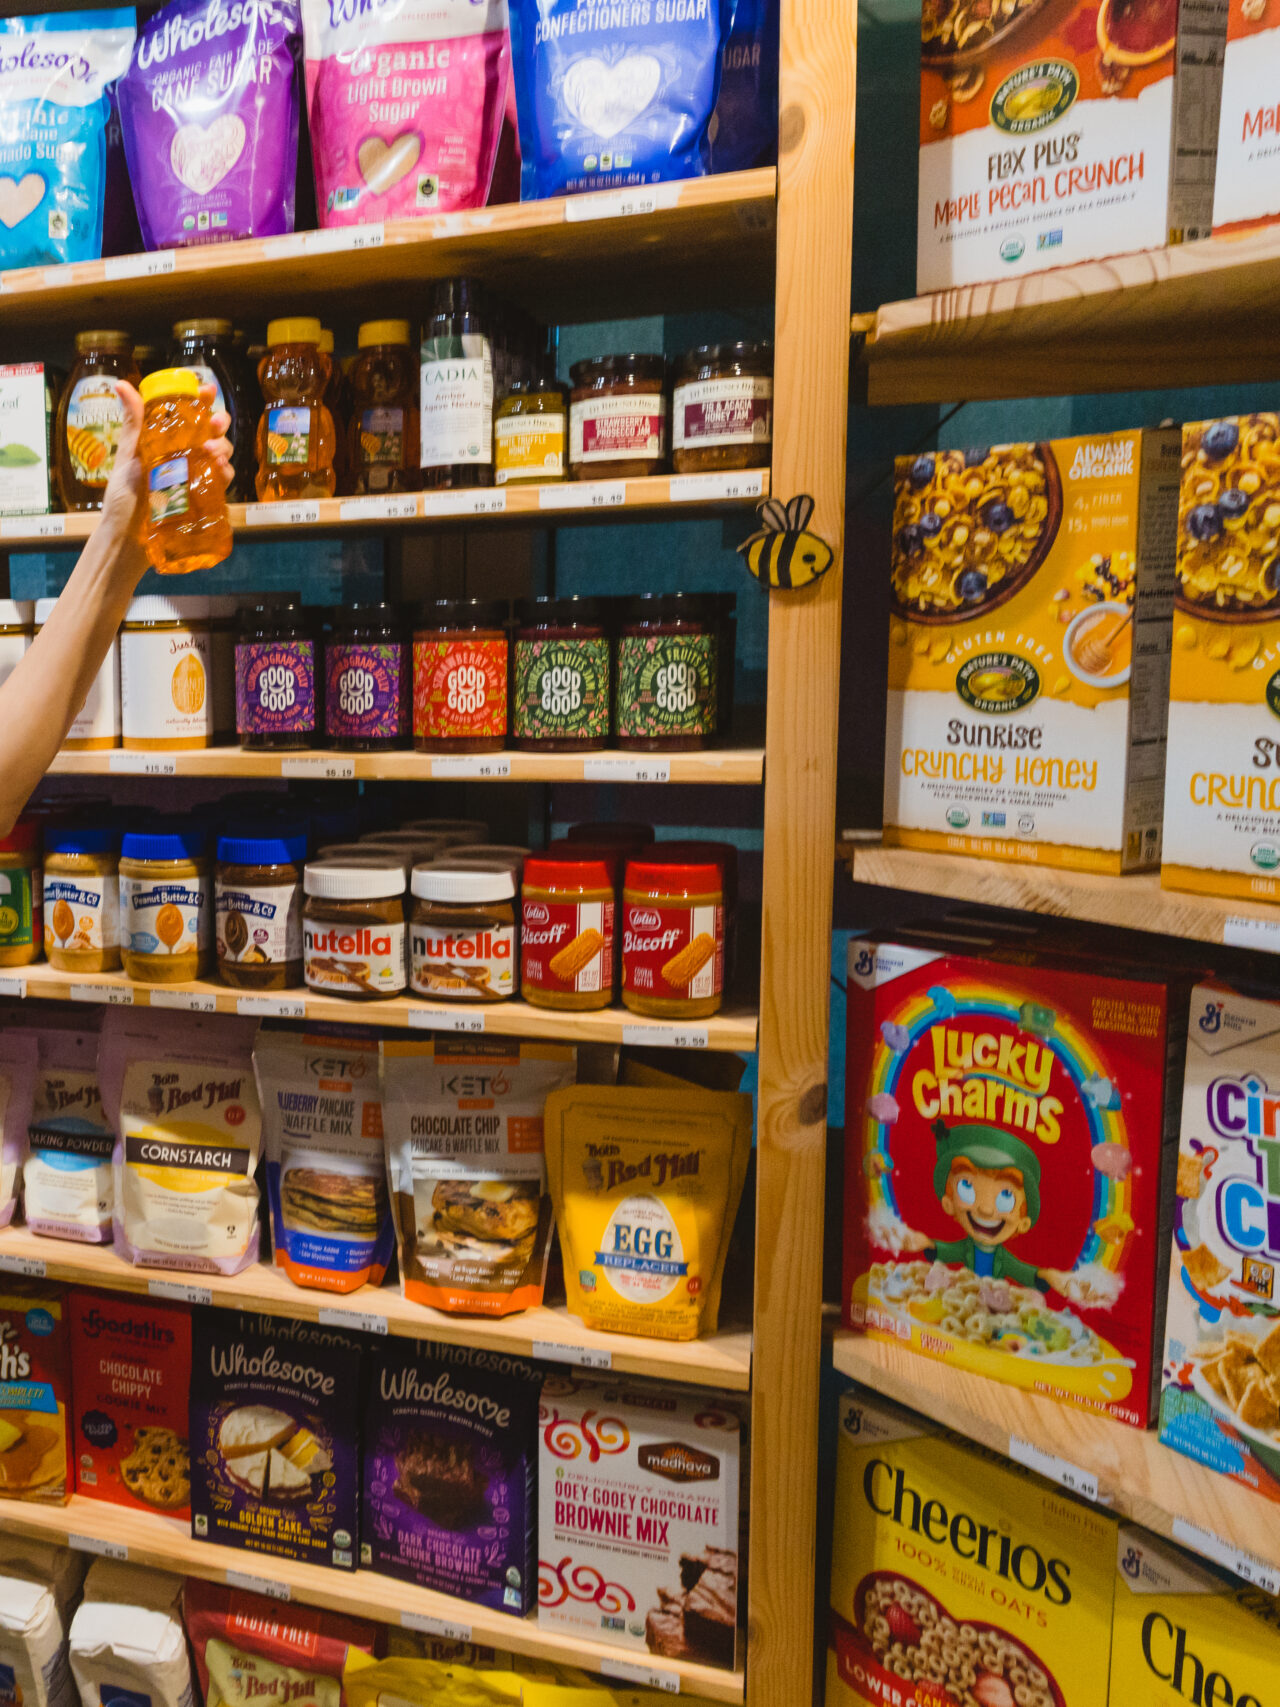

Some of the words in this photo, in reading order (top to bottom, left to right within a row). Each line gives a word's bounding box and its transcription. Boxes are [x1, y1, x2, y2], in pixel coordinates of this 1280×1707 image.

[535, 4, 651, 45] CONFECTIONERS
[656, 1, 707, 23] SUGAR
[348, 77, 386, 105] Light
[391, 76, 447, 97] Brown
[369, 101, 419, 124] Sugar
[424, 367, 478, 386] CADIA
[702, 402, 713, 412] FIG
[722, 399, 752, 411] ACACIA
[704, 411, 729, 423] HONEY
[731, 410, 749, 421] JAM
[596, 417, 642, 428] STRAWBERRY
[596, 427, 635, 437] PROSECCO
[637, 426, 651, 436] JAM
[945, 631, 1005, 665] GLUTEN
[1016, 633, 1054, 666] FREE
[259, 665, 294, 691] GOOD
[340, 668, 374, 693] GOOD
[448, 666, 485, 691] GOOD
[542, 666, 581, 692] GOOD
[657, 662, 696, 689] GOOD
[960, 655, 1008, 681] NATURE'S
[1010, 657, 1035, 681] PATH
[260, 689, 295, 711] GOOD
[340, 692, 374, 715] GOOD
[448, 689, 485, 714] GOOD
[542, 691, 581, 715] GOOD
[656, 687, 696, 712] GOOD
[973, 698, 1020, 712] ORGANIC
[133, 894, 160, 906] Peanut
[161, 891, 187, 904] Butter
[304, 928, 392, 956] nutella
[413, 931, 511, 960] nutella
[521, 922, 568, 946] Biscoff
[624, 930, 680, 952] Biscoff
[930, 1025, 1055, 1095] Lucky
[320, 1100, 354, 1118] PANCAKE
[912, 1069, 1064, 1145] Charms
[285, 1114, 326, 1134] WAFFLE
[330, 1118, 352, 1135] MIX
[410, 1115, 472, 1135] CHOCOLATE
[475, 1116, 500, 1135] CHIP
[67, 1139, 112, 1152] POWDER
[140, 1144, 232, 1168] CORNSTARCH
[410, 1136, 443, 1154] PANCAKE
[452, 1137, 481, 1154] WAFFLE
[484, 1137, 500, 1153] MIX
[606, 1155, 652, 1192] Red
[613, 1223, 673, 1259] EGG
[603, 1257, 680, 1275] REPLACER
[99, 1359, 164, 1386] CHOCOLATE
[211, 1344, 335, 1395] Wholesome
[111, 1379, 151, 1399] CHIPPY
[380, 1367, 511, 1428] Wholesome
[647, 1454, 711, 1474] madhava
[239, 1509, 275, 1530] GOLDEN
[278, 1516, 302, 1534] CAKE
[554, 1501, 632, 1539] BROWNIE
[636, 1516, 670, 1546] MIX
[641, 1496, 719, 1526] CHOCOLATE
[863, 1458, 1072, 1607] Cheerios
[426, 1535, 482, 1562] CHOCOLATE
[894, 1537, 947, 1577] 100%
[990, 1586, 1049, 1629] OATS
[234, 1613, 279, 1640] GLUTEN
[283, 1623, 312, 1647] FREE
